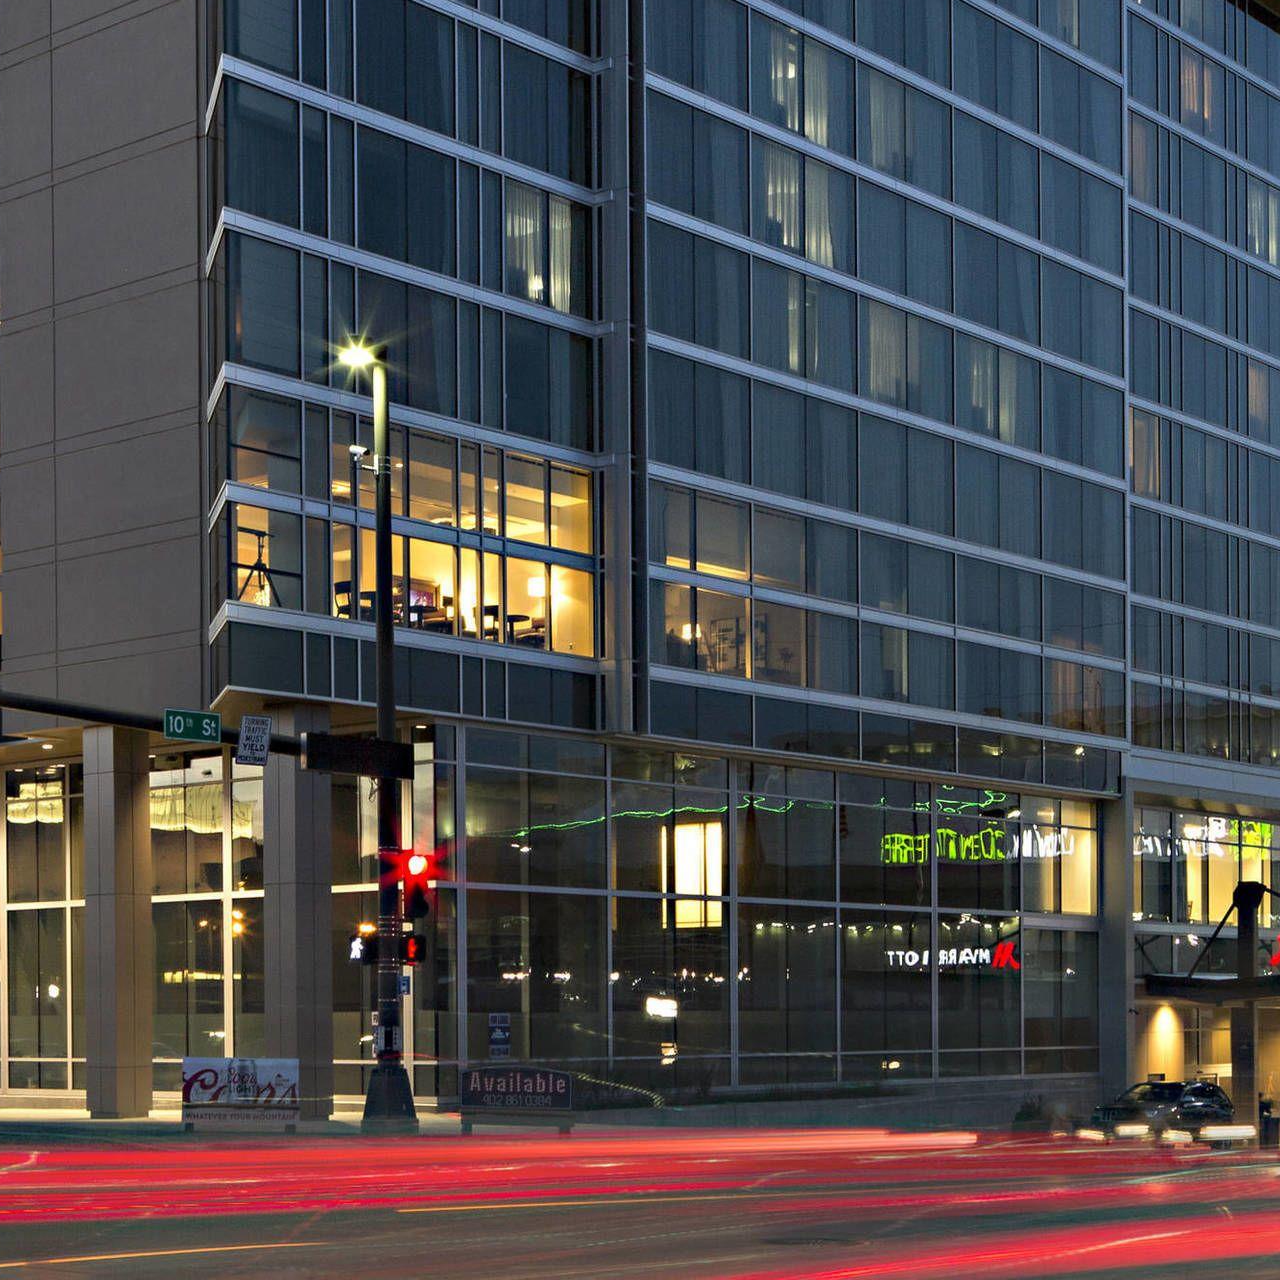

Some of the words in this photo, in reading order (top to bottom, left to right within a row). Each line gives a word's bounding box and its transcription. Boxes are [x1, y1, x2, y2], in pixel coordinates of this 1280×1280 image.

[245, 735, 264, 743] MUST
[243, 743, 265, 751] YIELD
[470, 1071, 566, 1093] Available
[230, 1111, 251, 1121] YOUR
